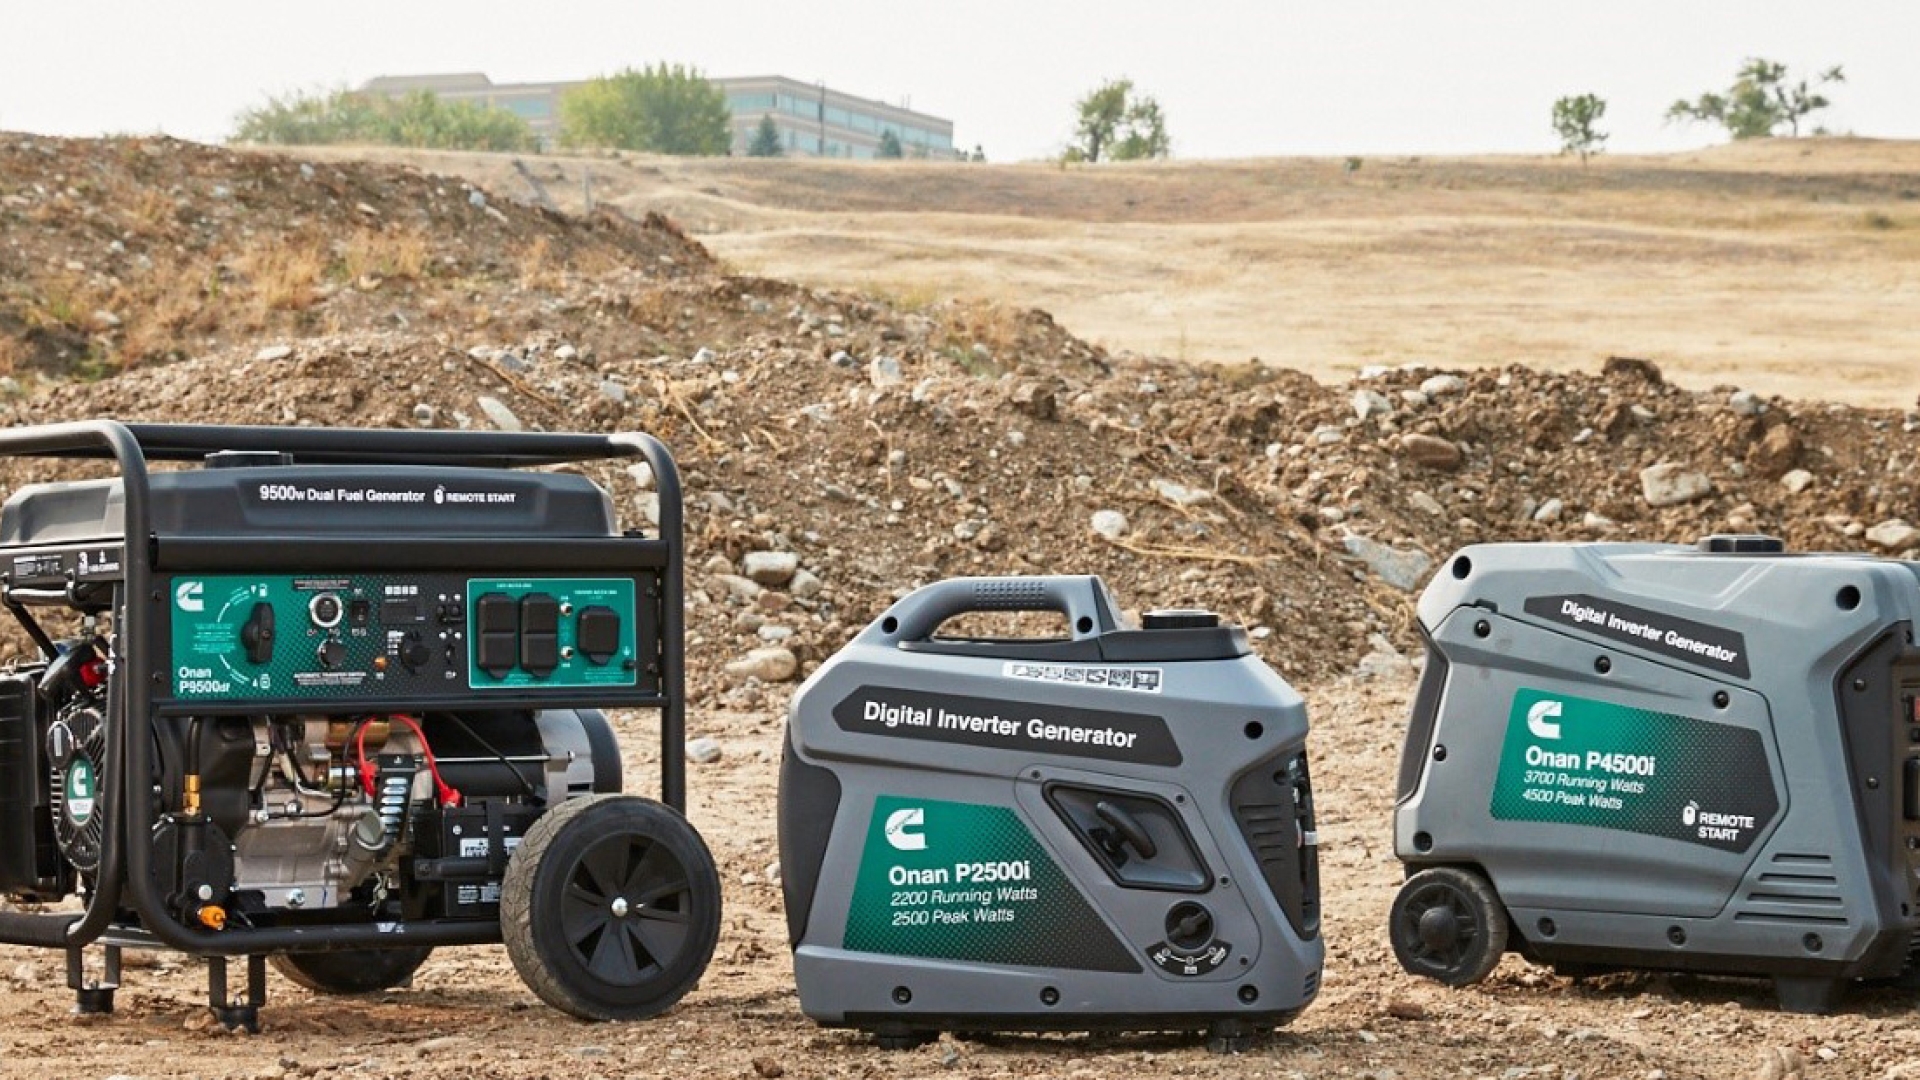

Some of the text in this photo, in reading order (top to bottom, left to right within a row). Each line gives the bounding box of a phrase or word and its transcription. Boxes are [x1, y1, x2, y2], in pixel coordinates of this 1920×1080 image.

[307, 488, 335, 501] Dual
[338, 489, 363, 502] Fuel
[366, 489, 425, 503] Generator
[446, 493, 516, 503] REMOTE START
[1561, 599, 1738, 663] Digital Inverter Generator
[178, 666, 212, 679] Onan
[863, 701, 1137, 748] Digital Inverter Generator
[1525, 745, 1656, 776] Onan P4500i
[1523, 770, 1645, 794] 3700 Running Watts
[1522, 788, 1622, 810] 4500 Peak Watts
[1699, 811, 1755, 828] REMOTE
[1698, 826, 1740, 842] START
[889, 860, 1031, 886] Onan P2500i
[890, 887, 1038, 906] 2200 Running Watts
[891, 907, 1015, 926] 2500 Peak Watts
